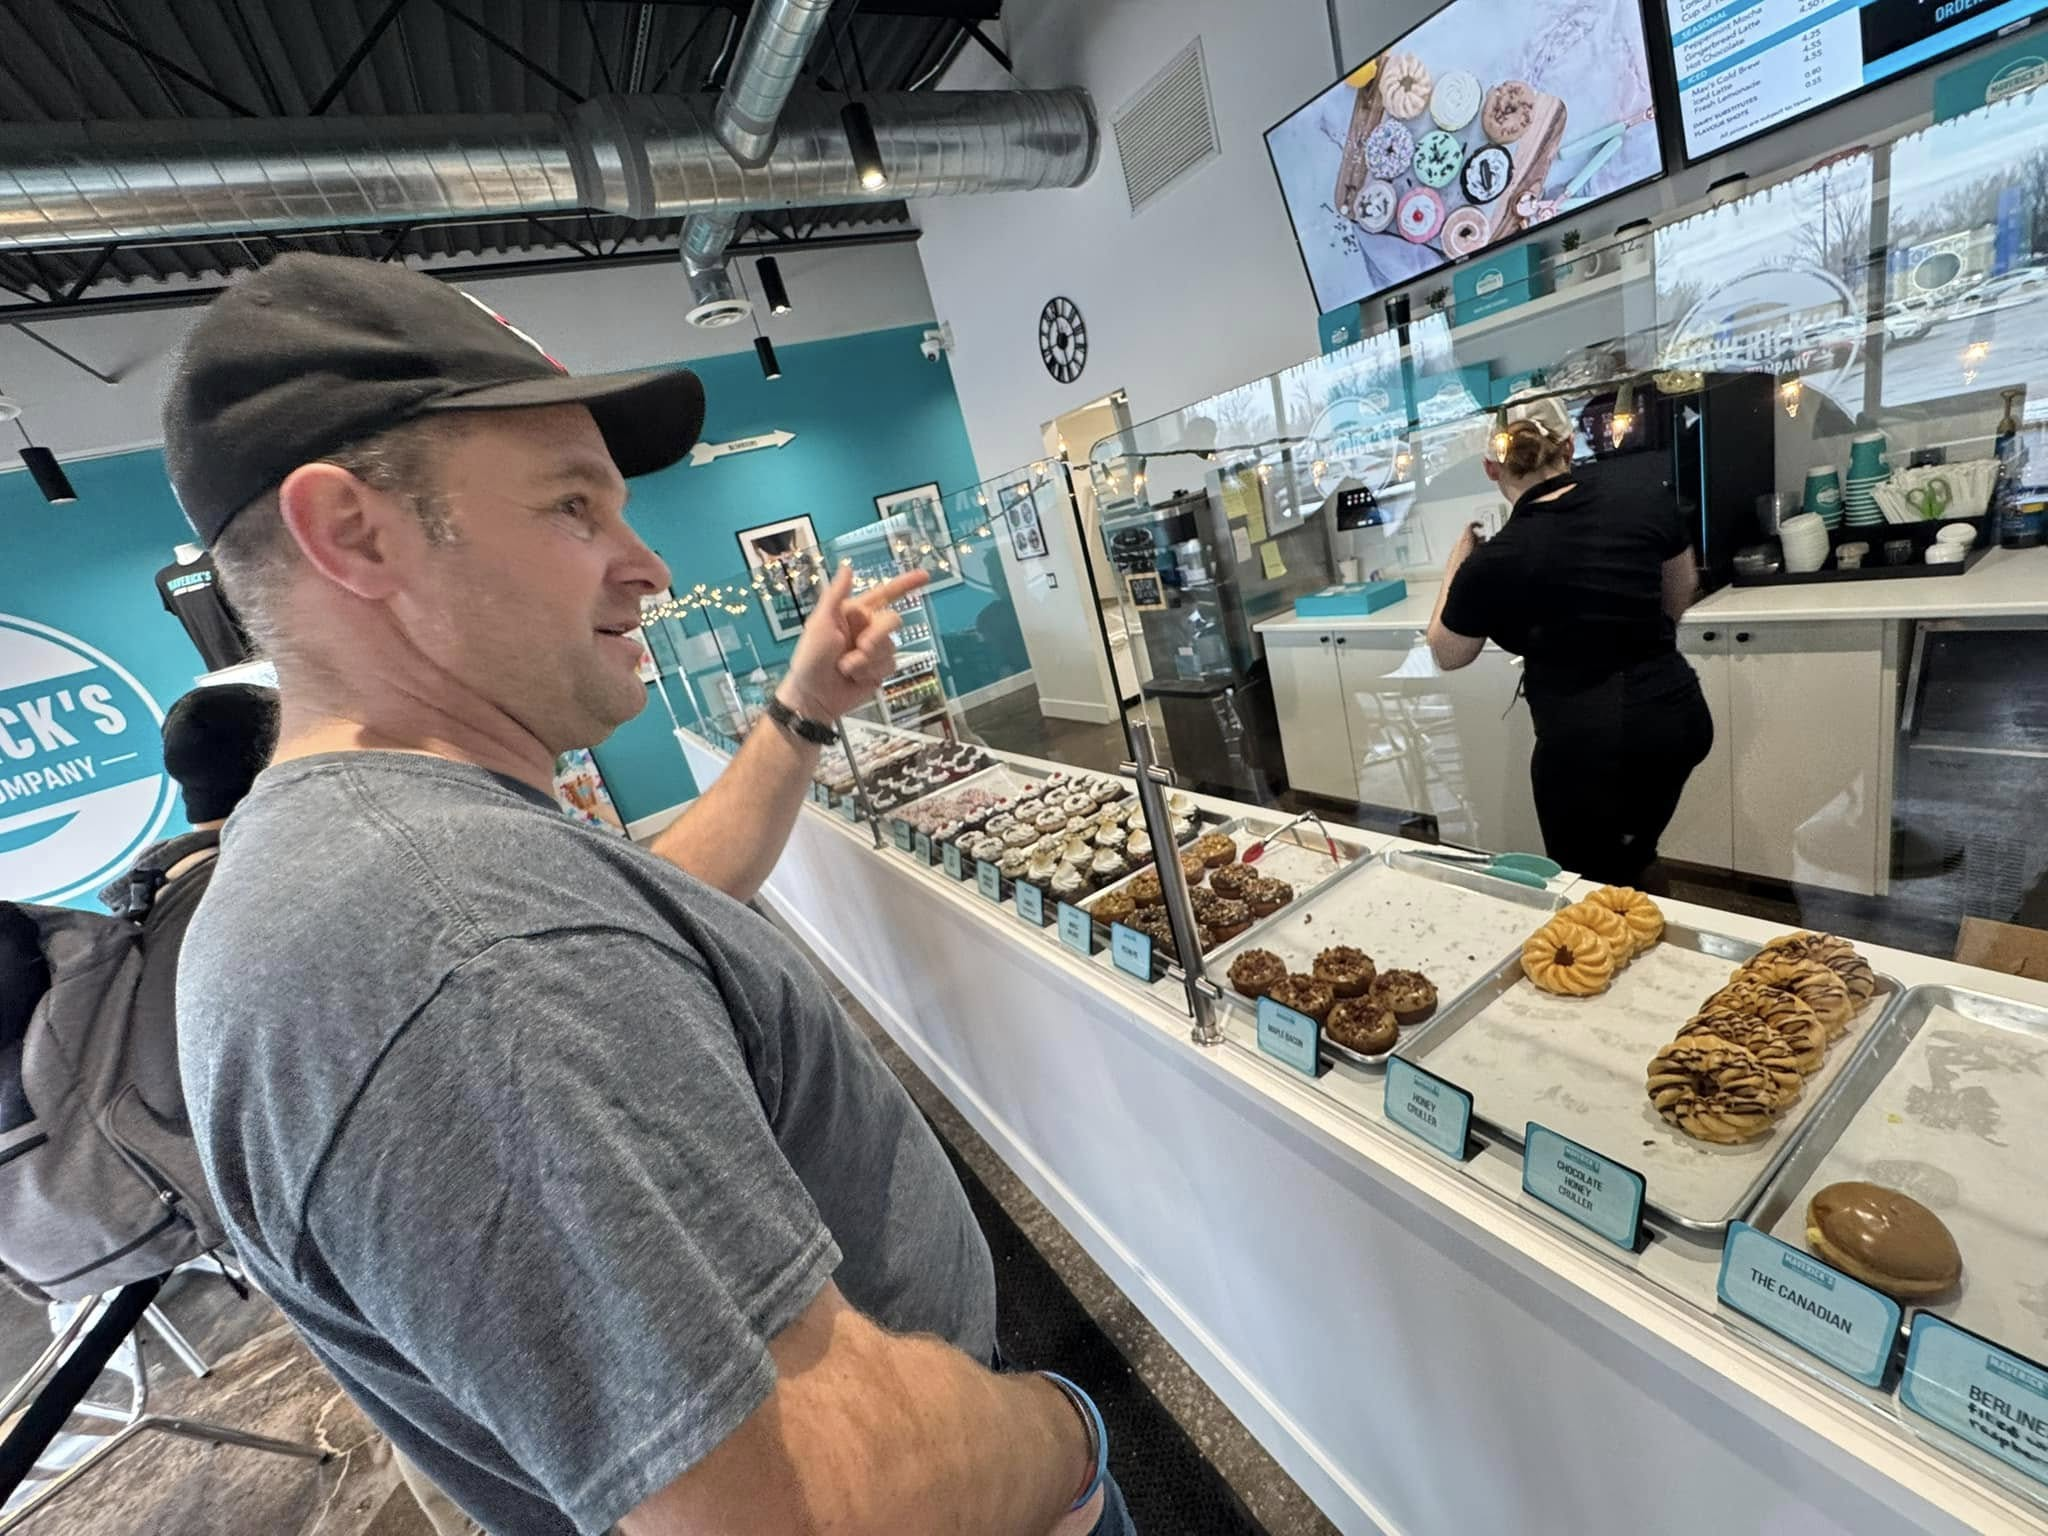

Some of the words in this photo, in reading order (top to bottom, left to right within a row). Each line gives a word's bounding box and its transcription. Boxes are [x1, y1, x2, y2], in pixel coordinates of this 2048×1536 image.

[1681, 10, 1700, 23] Cup
[1702, 0, 1711, 11] of
[1681, 10, 1727, 38] SEASONAL
[1683, 23, 1730, 52] Peppermint
[1733, 7, 1763, 26] Mocha
[1684, 30, 1737, 62] Gingerbread
[1738, 19, 1761, 35] Latte
[1686, 59, 1701, 71] Hot
[1703, 38, 1745, 63] Chocolate
[1687, 70, 1708, 84] ICED
[1691, 80, 1715, 97] Mav's
[1716, 70, 1737, 85] Cold
[1739, 60, 1761, 75] Brew
[1693, 93, 1710, 105] Iced
[1711, 84, 1733, 100] Latte
[1694, 101, 1715, 114] Fresh
[1718, 80, 1761, 103] Lemonade
[1693, 116, 1713, 129] DAIRY
[1715, 95, 1758, 119] SUBSTITUTES
[1694, 120, 1725, 137] FLAVOUR
[1726, 109, 1749, 125] SHOTS
[1407, 1102, 1437, 1128] CRULLER
[1412, 1091, 1437, 1113] HONEY
[1556, 1159, 1604, 1193] CHOCOLATE
[1564, 1175, 1592, 1198] HONEY
[1558, 1184, 1593, 1212] CRULLER
[1751, 1267, 1777, 1293] THE
[1778, 1284, 1853, 1335] CANADIAN
